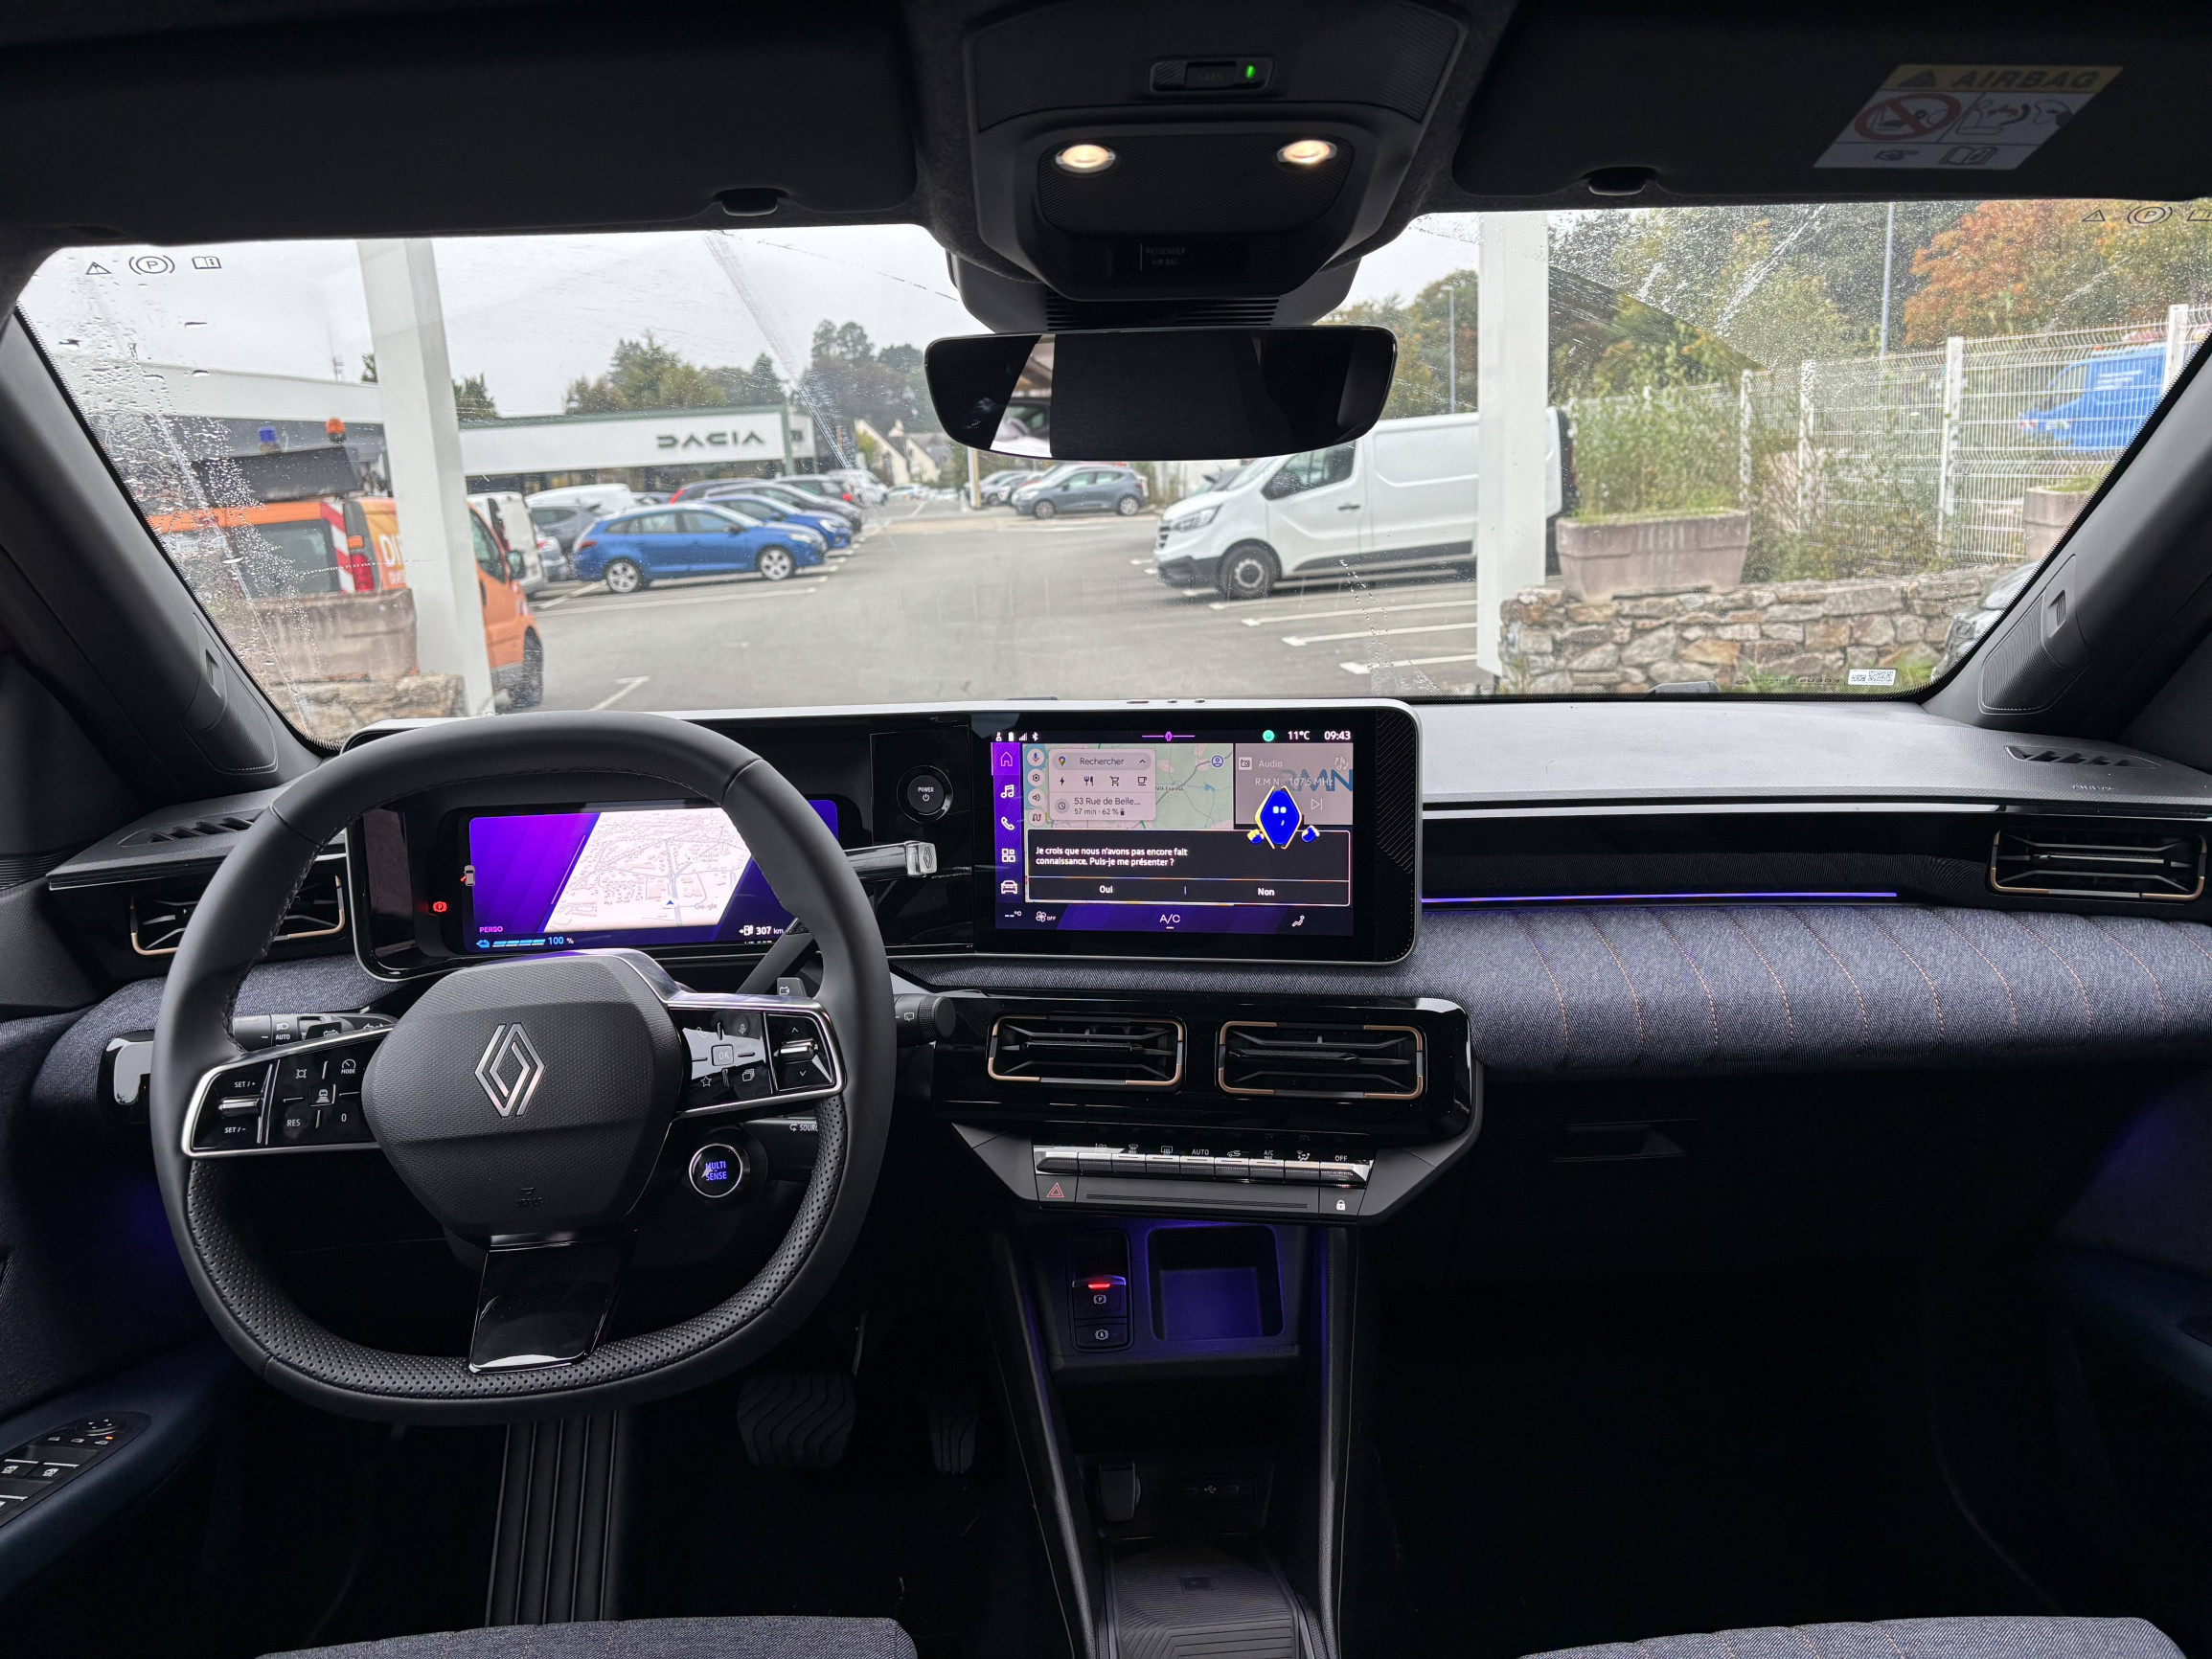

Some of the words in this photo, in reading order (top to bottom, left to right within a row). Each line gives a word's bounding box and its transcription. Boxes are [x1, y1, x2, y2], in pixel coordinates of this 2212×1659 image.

[1951, 70, 2101, 90] AIRBAG
[1145, 246, 1186, 255] PASSENGER
[656, 430, 765, 448] DACIA
[1288, 730, 1311, 740] 11°C
[1324, 730, 1352, 740] 09:43
[1080, 757, 1125, 765] Rechercher
[1258, 760, 1283, 768] Audio
[1074, 797, 1084, 806] 53
[1085, 797, 1102, 806] Rue
[1103, 796, 1113, 806] de
[1114, 797, 1141, 806] Belle...
[1111, 807, 1120, 816] %
[1064, 848, 1080, 856] que
[1130, 849, 1146, 857] pas
[1174, 848, 1188, 856] fait
[1089, 857, 1116, 867] Puis-je
[1130, 857, 1169, 867] présenter
[1099, 884, 1113, 894] Oui
[1257, 887, 1275, 897] Non
[1159, 914, 1181, 924] A/C
[755, 925, 772, 936] 307
[548, 936, 564, 945] 100
[718, 1050, 730, 1060] OK
[286, 1119, 301, 1127] RES
[705, 1160, 726, 1170] MULTI
[705, 1170, 727, 1181] SENSE
